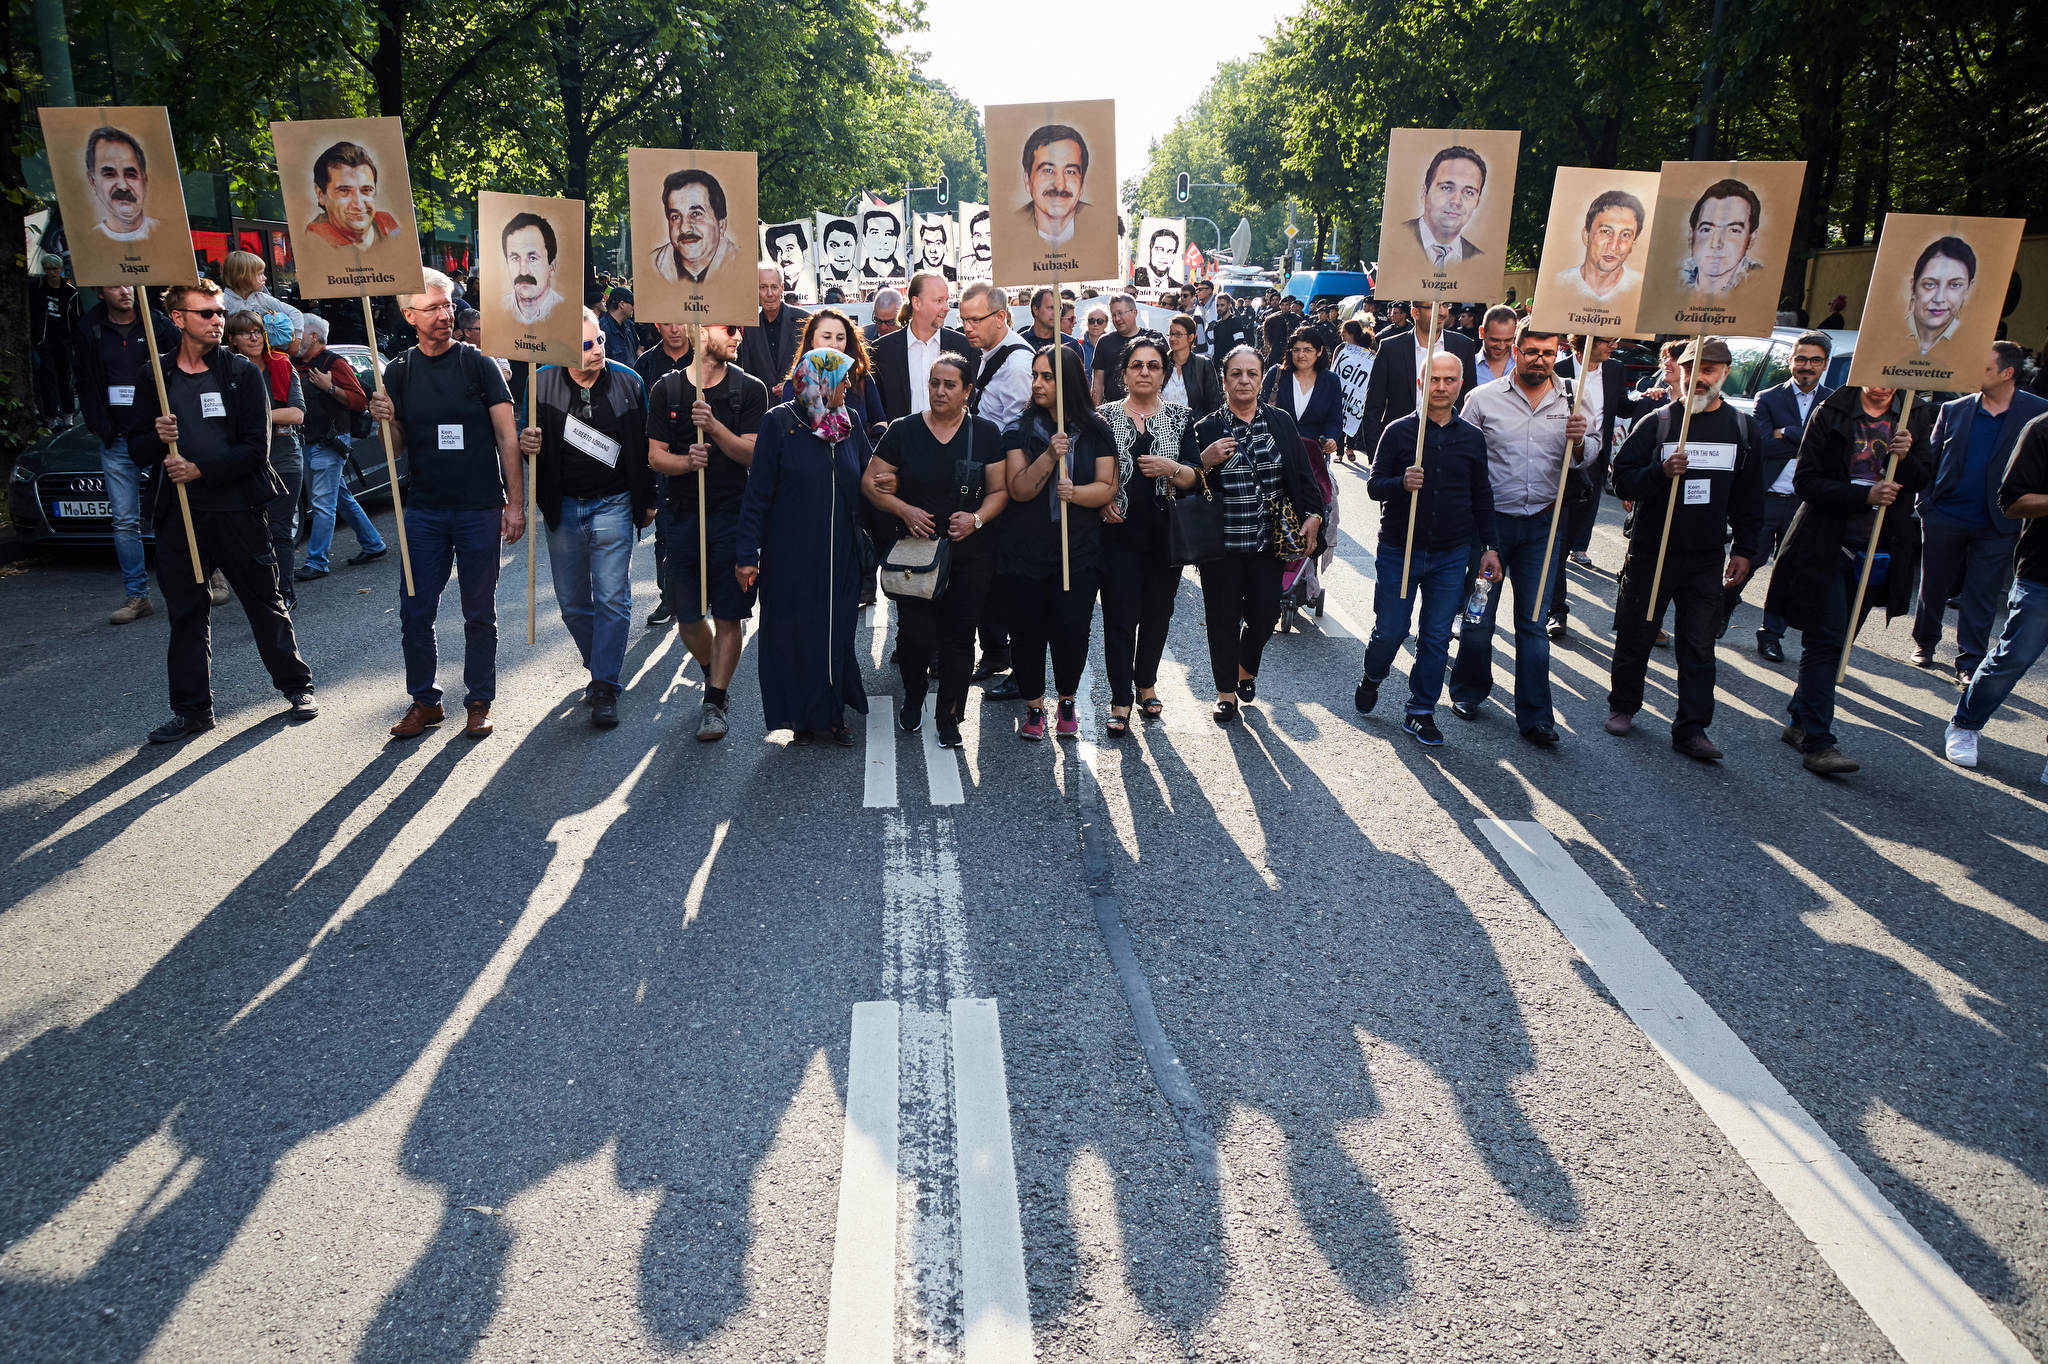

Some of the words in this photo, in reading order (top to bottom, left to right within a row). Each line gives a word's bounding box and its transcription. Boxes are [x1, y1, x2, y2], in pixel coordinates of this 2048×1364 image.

[120, 263, 150, 275] Yaşar
[1033, 259, 1079, 272] Kubaşık
[328, 272, 395, 286] Boulgarides
[1421, 279, 1458, 291] Yozgat
[684, 301, 710, 314] Kılıç
[1568, 312, 1622, 326] Taşköprü
[1675, 310, 1736, 325] Özüdoğru
[514, 339, 548, 352] Şimşek
[1335, 353, 1368, 387] Kein
[1881, 366, 1954, 379] Kiesewetter
[572, 428, 592, 441] ALBERTO
[63, 503, 73, 516] M
[80, 503, 96, 516] LG
